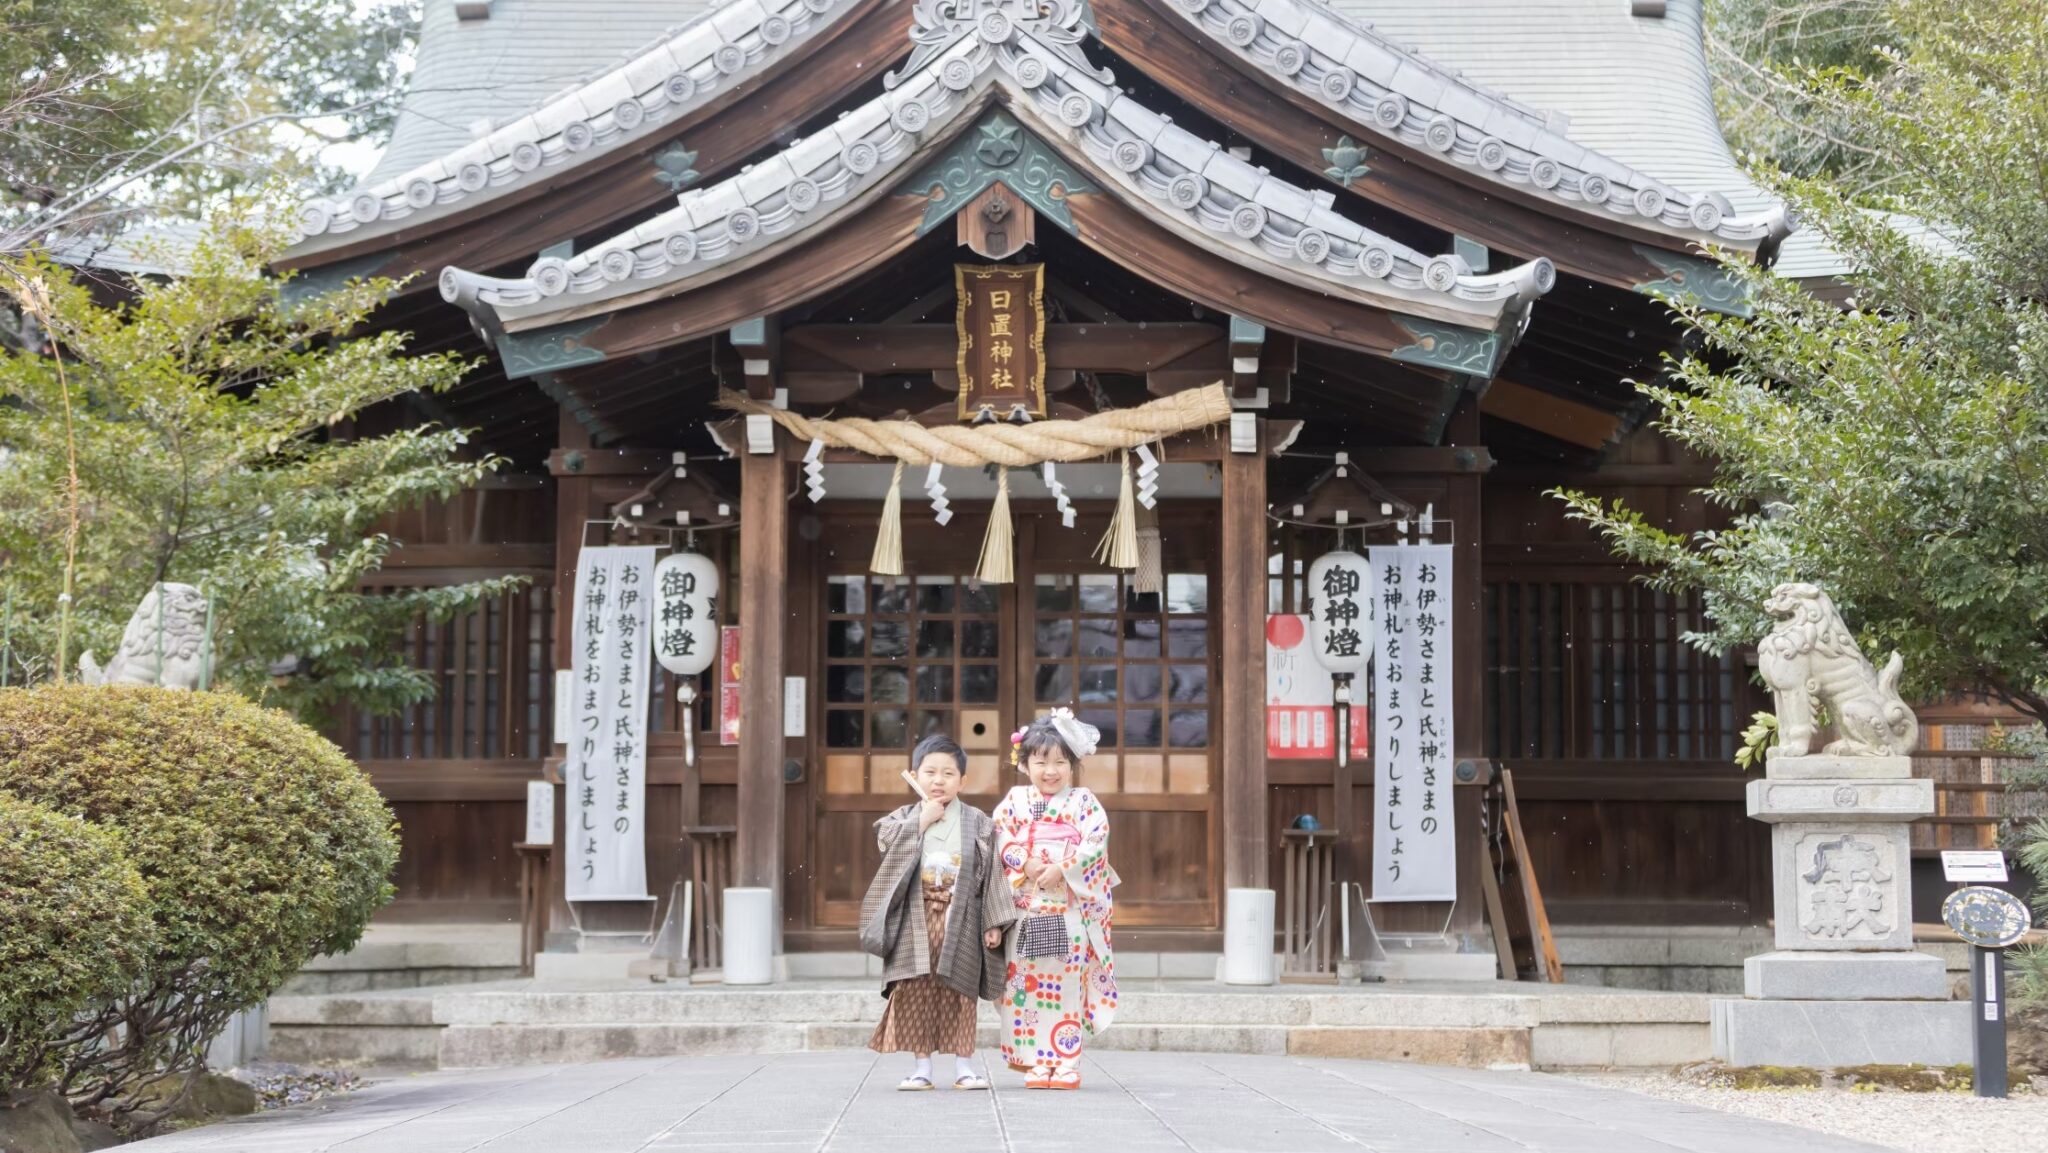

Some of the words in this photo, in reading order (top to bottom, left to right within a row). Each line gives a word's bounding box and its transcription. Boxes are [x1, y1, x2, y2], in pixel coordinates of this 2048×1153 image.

[989, 290, 1015, 390] 日置神社
[582, 566, 607, 881] お神札をおまつりしましょう
[613, 564, 640, 835] お伊勢さまと氏神さまの
[661, 566, 697, 657] 御神燈
[1322, 564, 1362, 657] 御神燈
[1383, 564, 1404, 882] お神札をおまつりしましょう
[1416, 563, 1439, 835] お伊勢さまと氏神さまの
